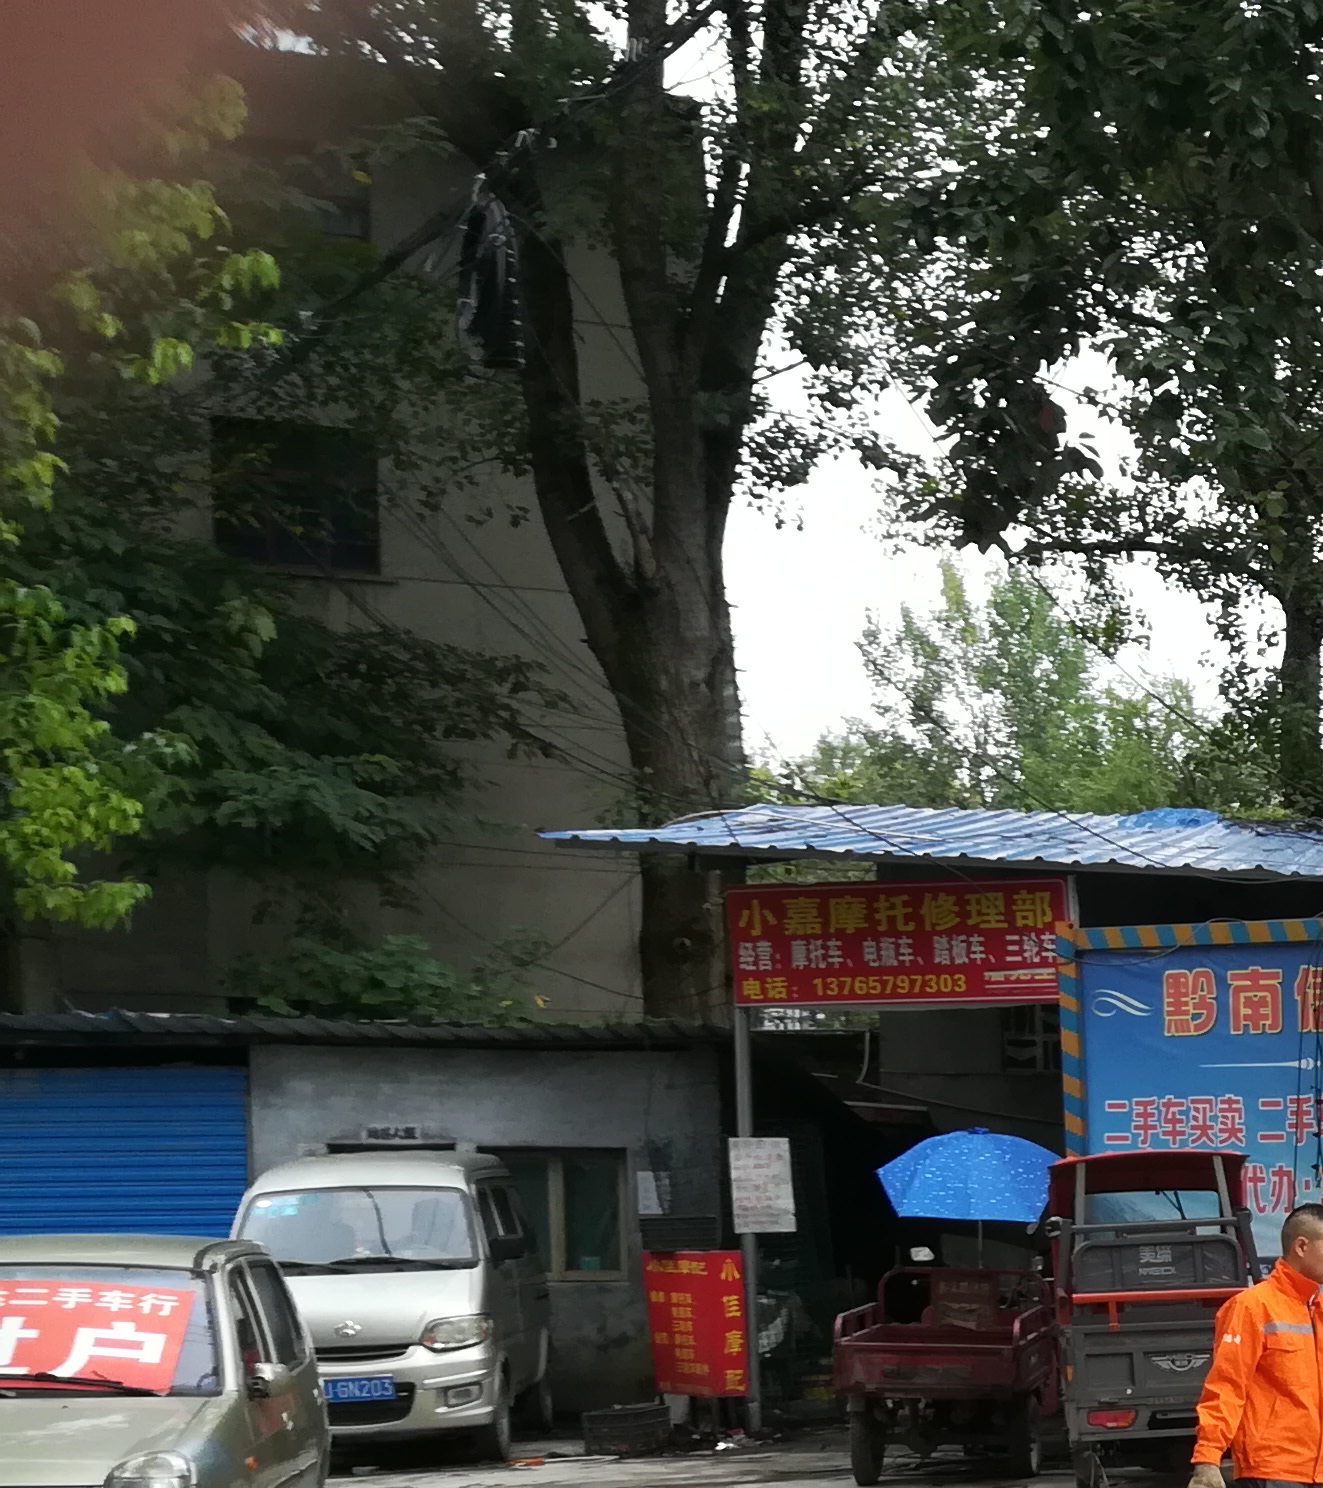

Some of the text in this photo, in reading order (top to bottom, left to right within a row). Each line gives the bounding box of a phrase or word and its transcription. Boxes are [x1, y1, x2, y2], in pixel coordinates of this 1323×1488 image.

[738, 889, 1054, 936] 小嘉摩托修理部
[1104, 1094, 1247, 1148] 二手车买卖
